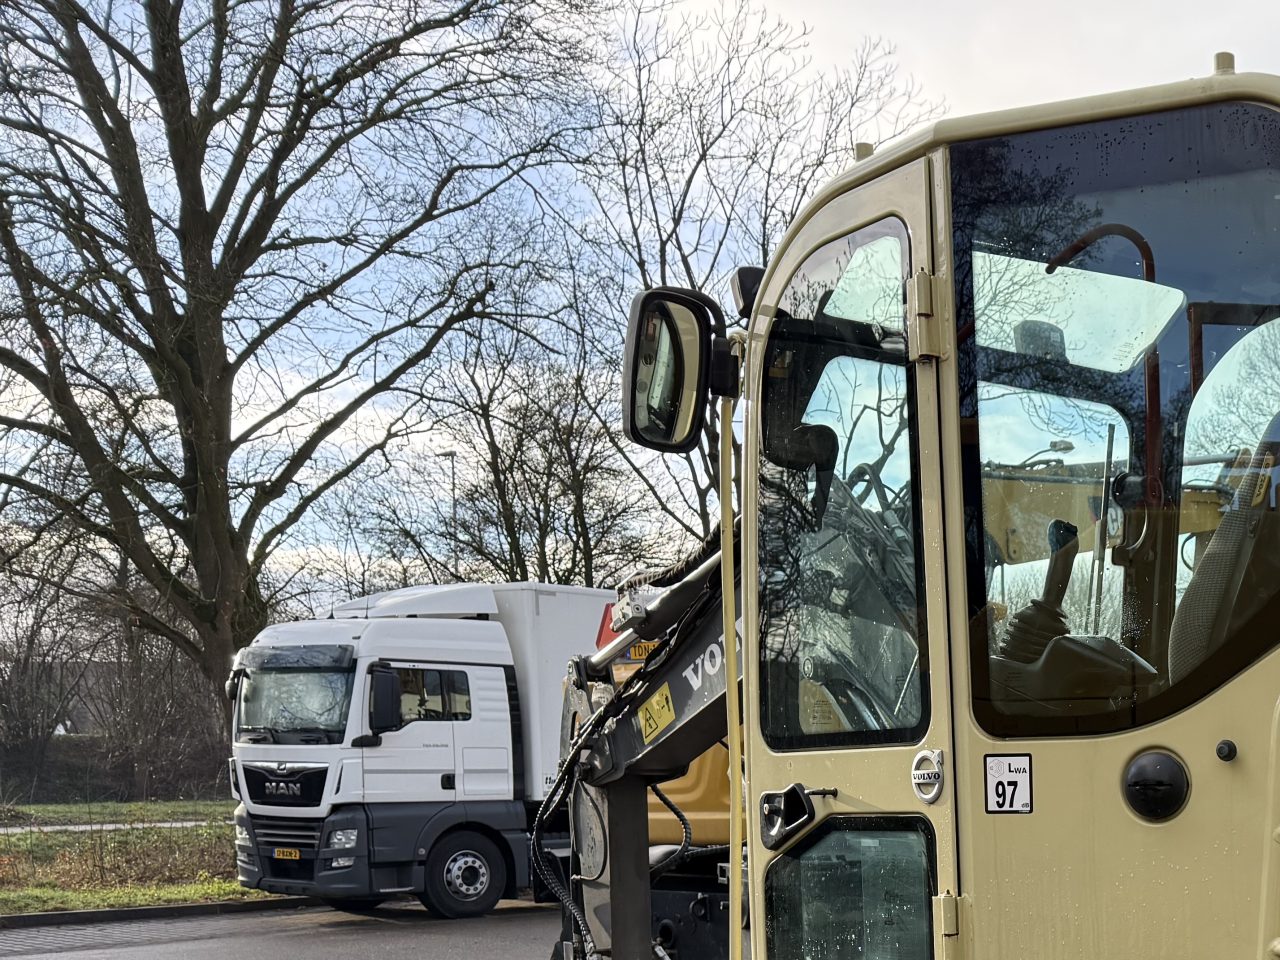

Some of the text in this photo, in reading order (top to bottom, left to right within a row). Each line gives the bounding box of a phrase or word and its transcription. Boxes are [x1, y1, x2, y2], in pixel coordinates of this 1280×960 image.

[912, 772, 941, 780] VOLVO
[264, 782, 301, 796] MAN
[995, 780, 1018, 808] 97
